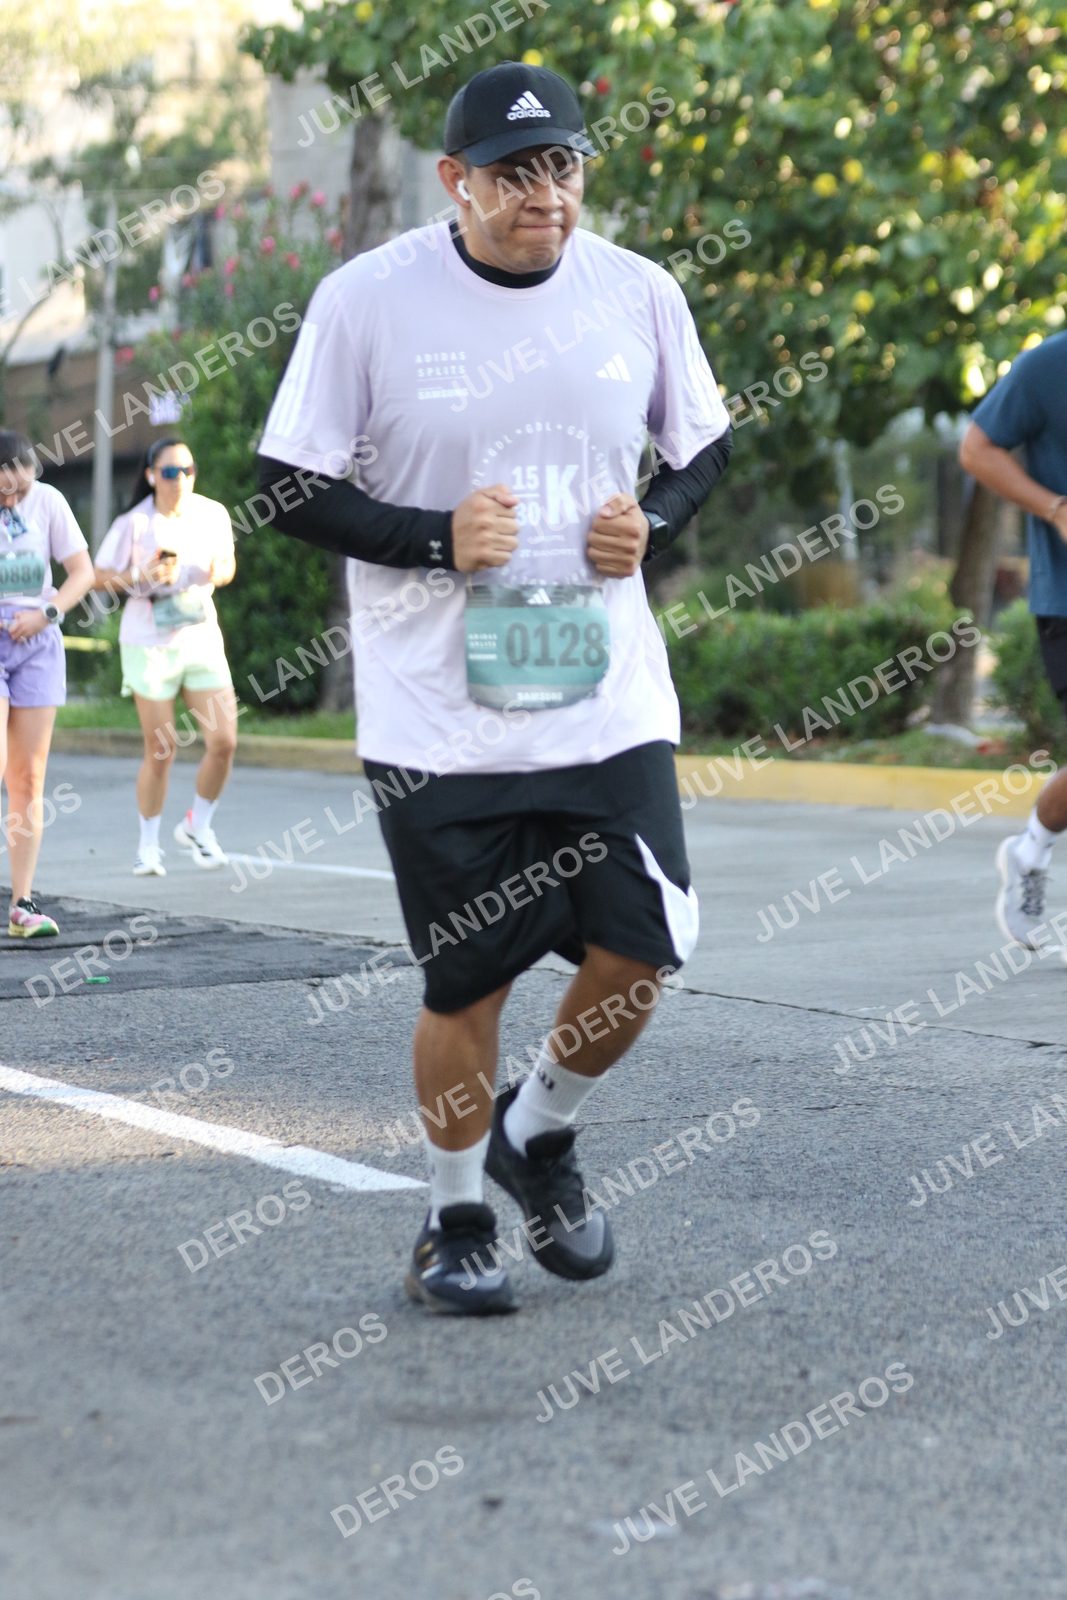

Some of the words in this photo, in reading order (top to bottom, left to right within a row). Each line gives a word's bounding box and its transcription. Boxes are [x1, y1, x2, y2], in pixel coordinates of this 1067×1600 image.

[506, 109, 551, 121] adidas
[511, 465, 540, 489] 15
[546, 464, 581, 524] K
[505, 621, 606, 668] 0128
